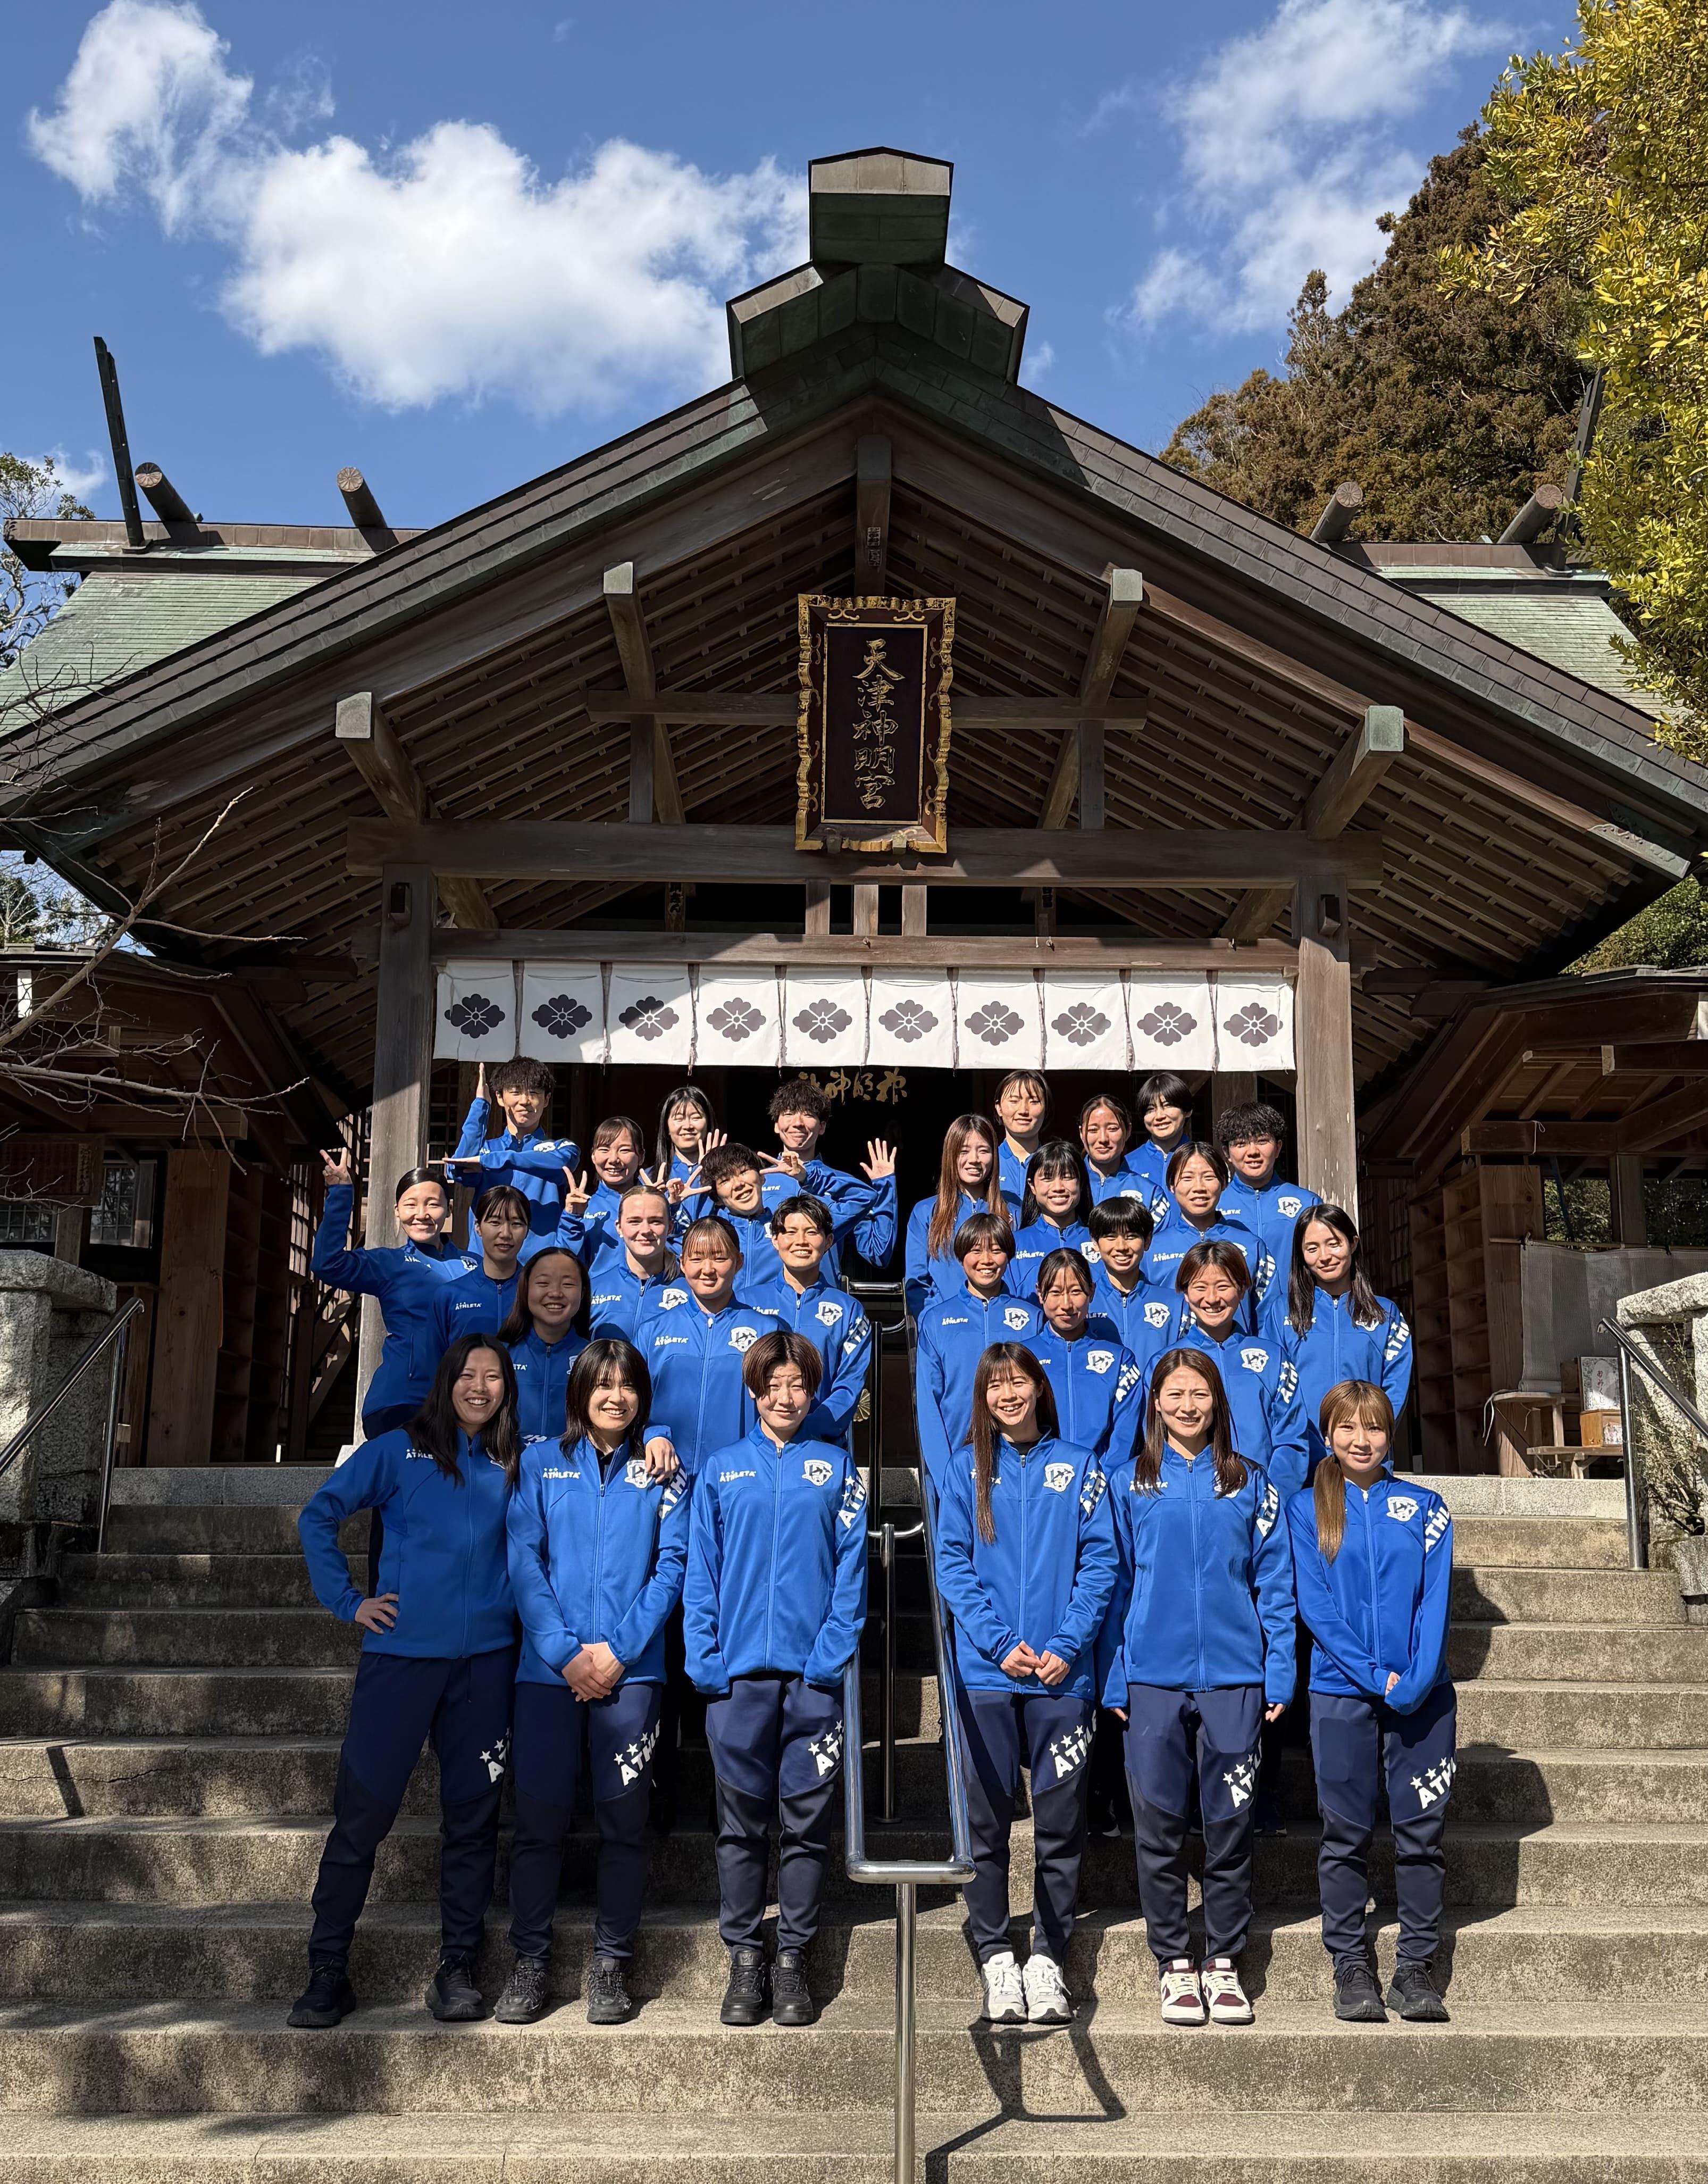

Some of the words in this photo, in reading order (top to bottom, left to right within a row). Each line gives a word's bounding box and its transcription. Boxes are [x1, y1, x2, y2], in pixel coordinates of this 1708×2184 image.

[852, 639, 905, 809] 天津神明宮
[655, 1337, 688, 1346] ATHLETA
[719, 1471, 756, 1482] ATHLETA
